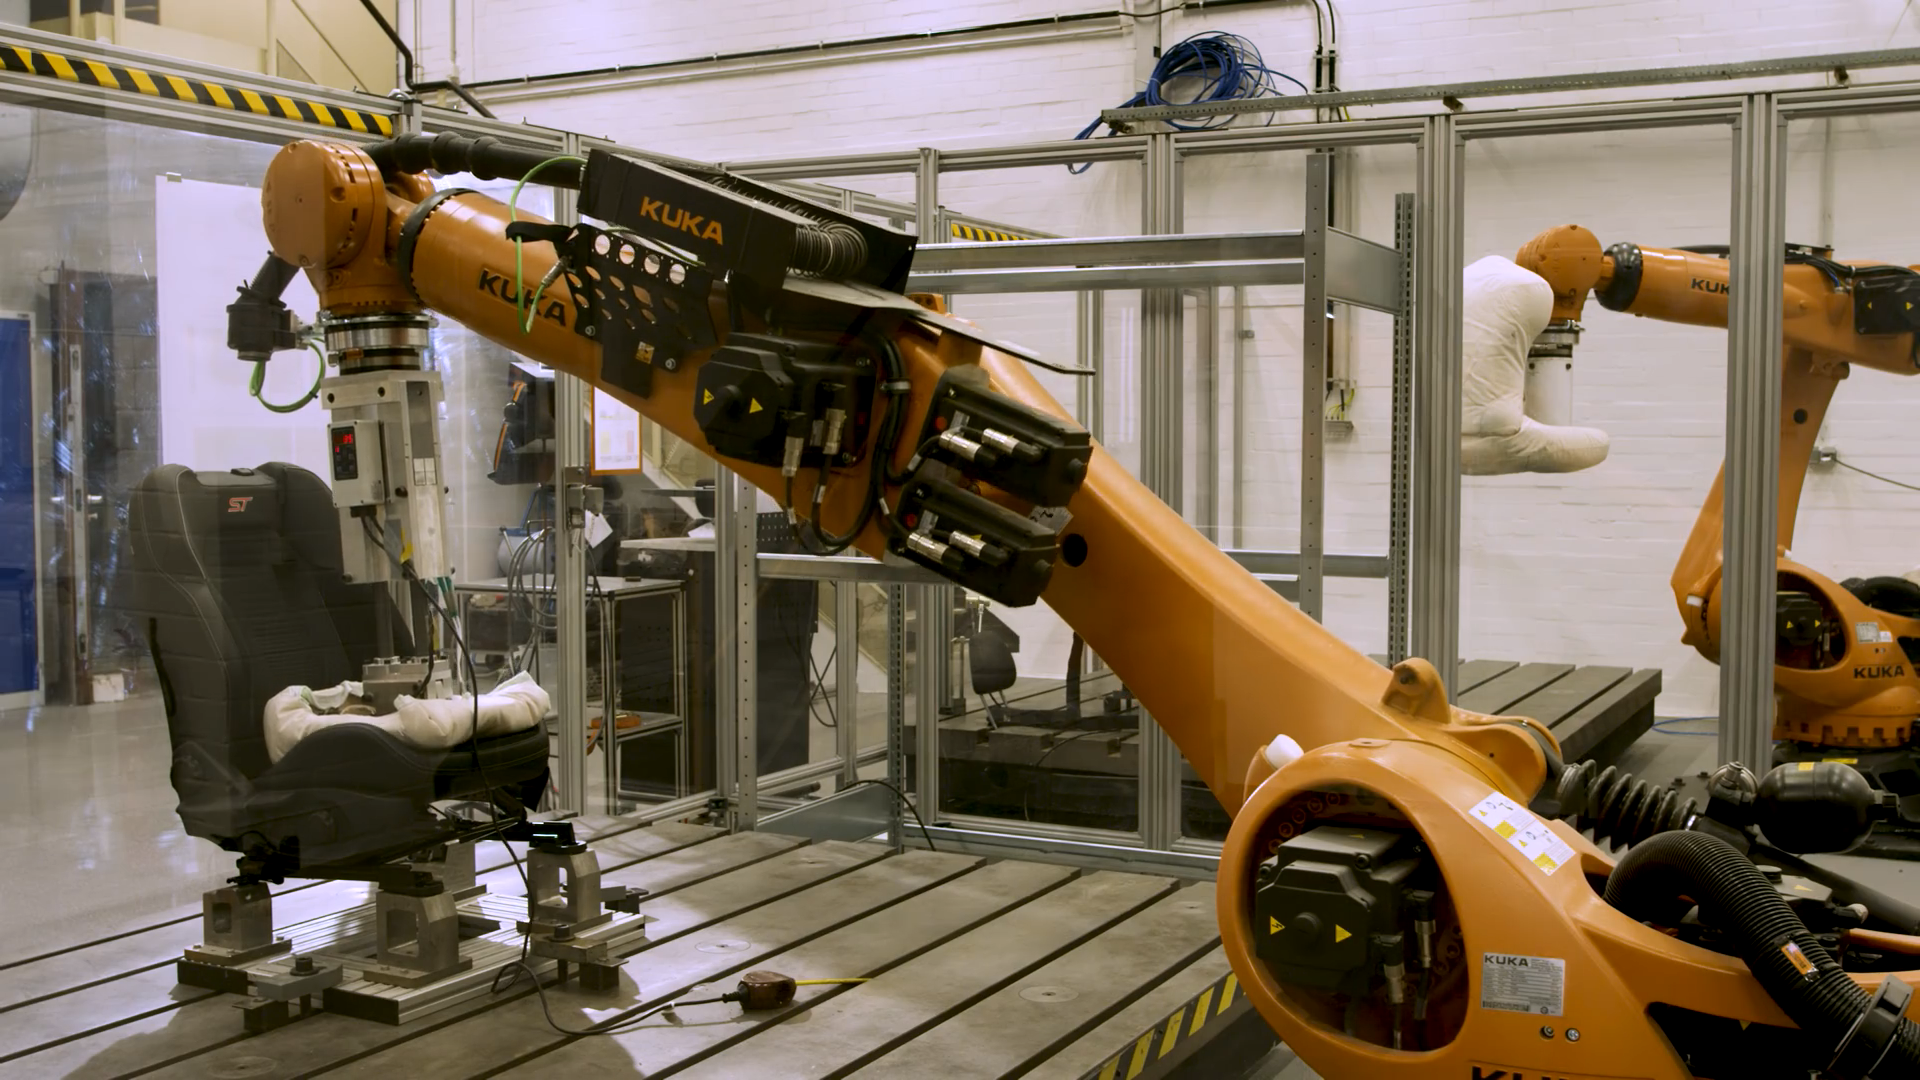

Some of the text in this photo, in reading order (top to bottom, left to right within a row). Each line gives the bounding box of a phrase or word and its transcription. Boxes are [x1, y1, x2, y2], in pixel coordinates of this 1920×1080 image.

[640, 196, 723, 245] KUKA
[1691, 278, 1730, 296] KUK
[478, 268, 567, 327] KUKA
[228, 496, 253, 512] ST
[1854, 665, 1905, 679] KUKA
[1484, 954, 1529, 967] KUKA
